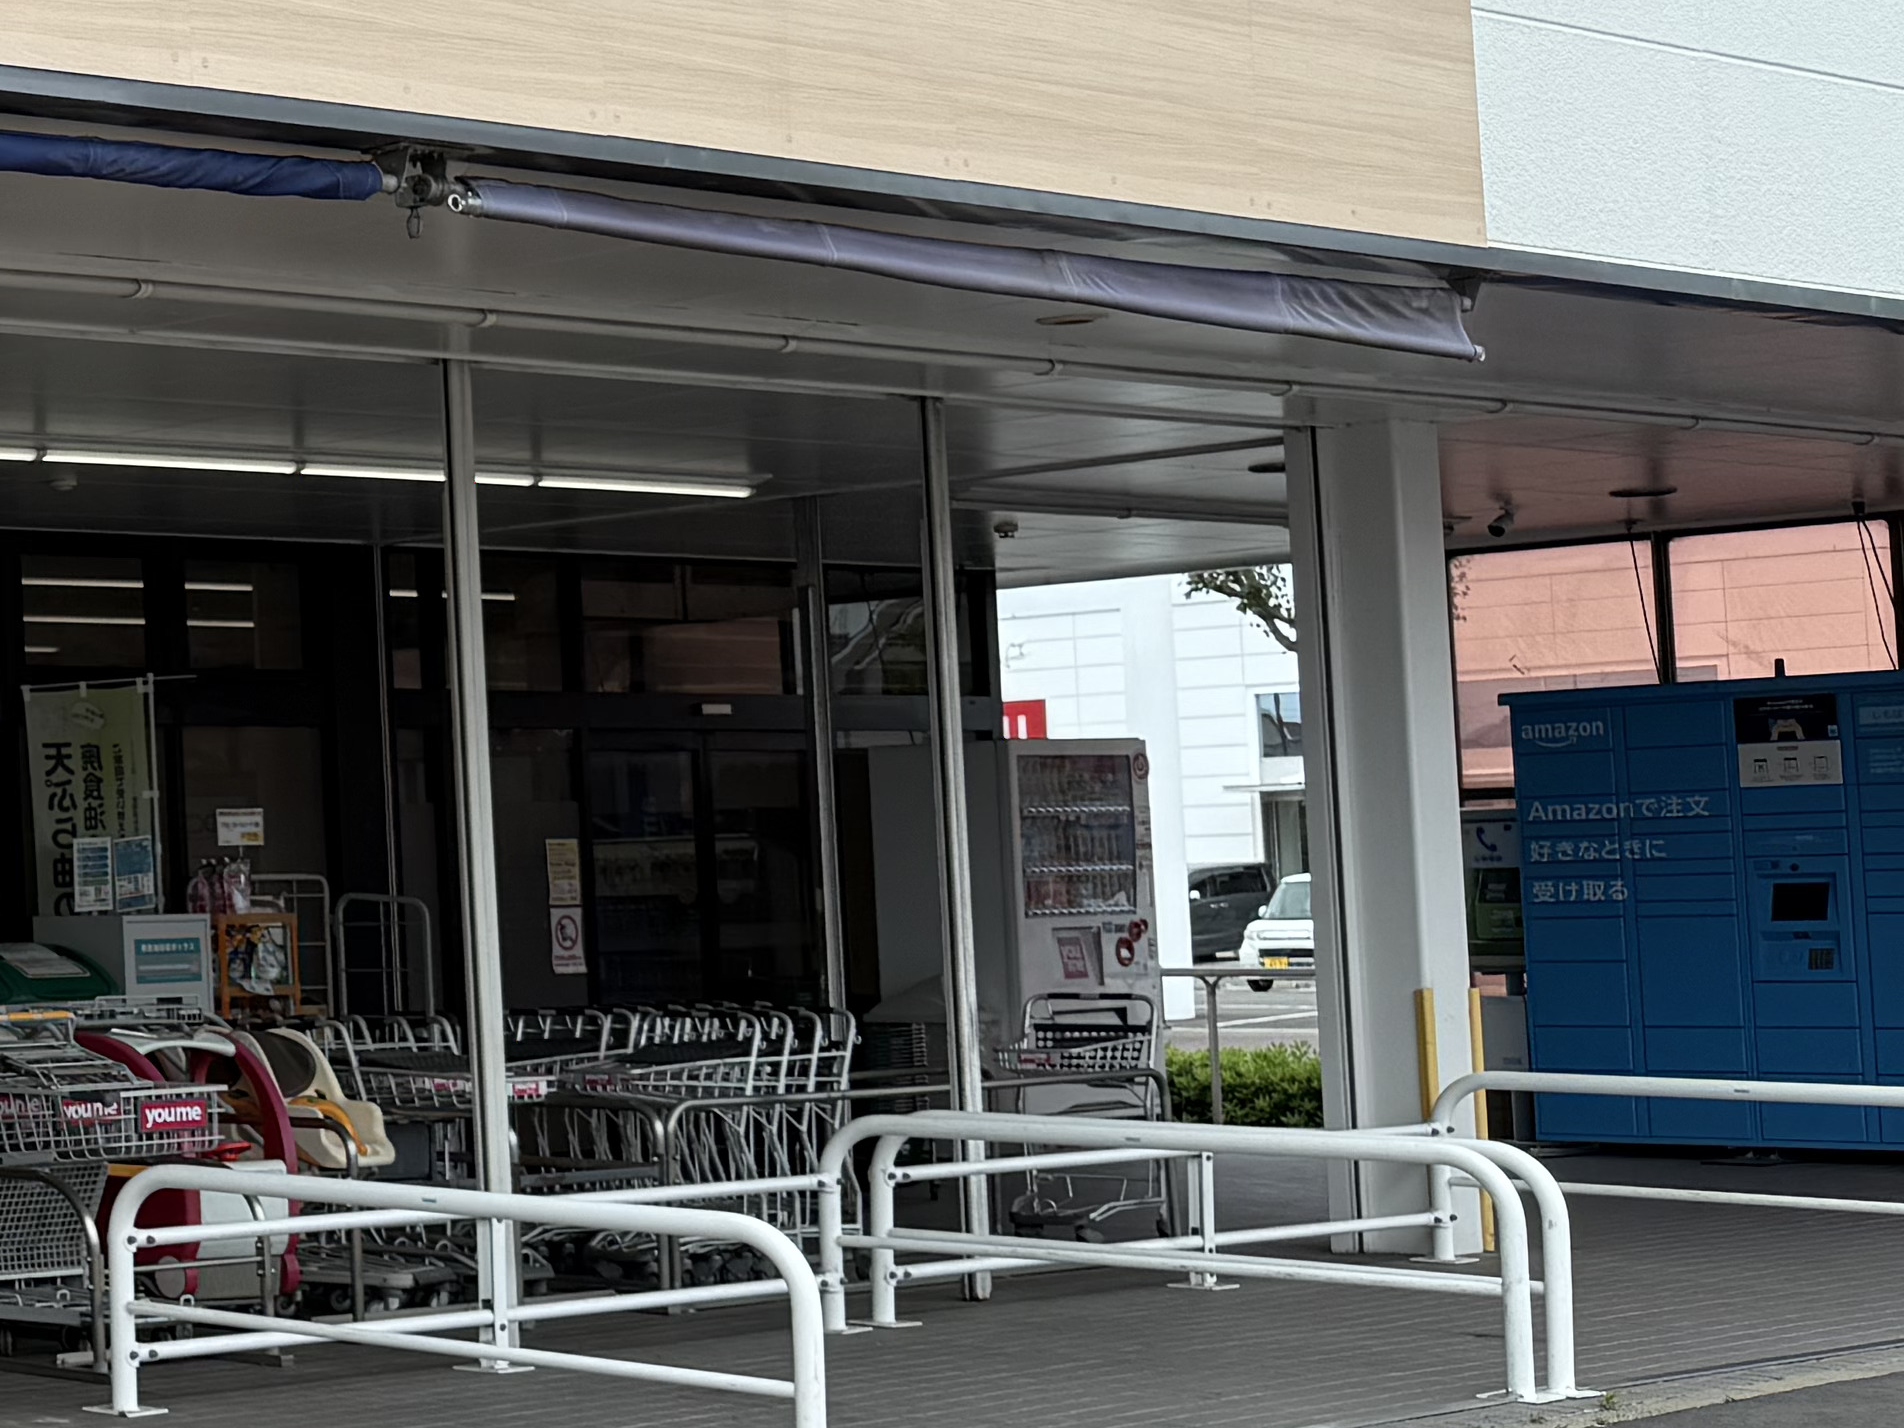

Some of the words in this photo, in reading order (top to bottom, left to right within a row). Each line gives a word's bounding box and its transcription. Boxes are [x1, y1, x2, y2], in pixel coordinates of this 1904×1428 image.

[1521, 720, 1604, 740] amazon
[1528, 796, 1709, 821] Amazonで注文
[1530, 839, 1667, 862] 好きなときに
[1533, 880, 1628, 903] 受け取る
[145, 1104, 202, 1129] youme
